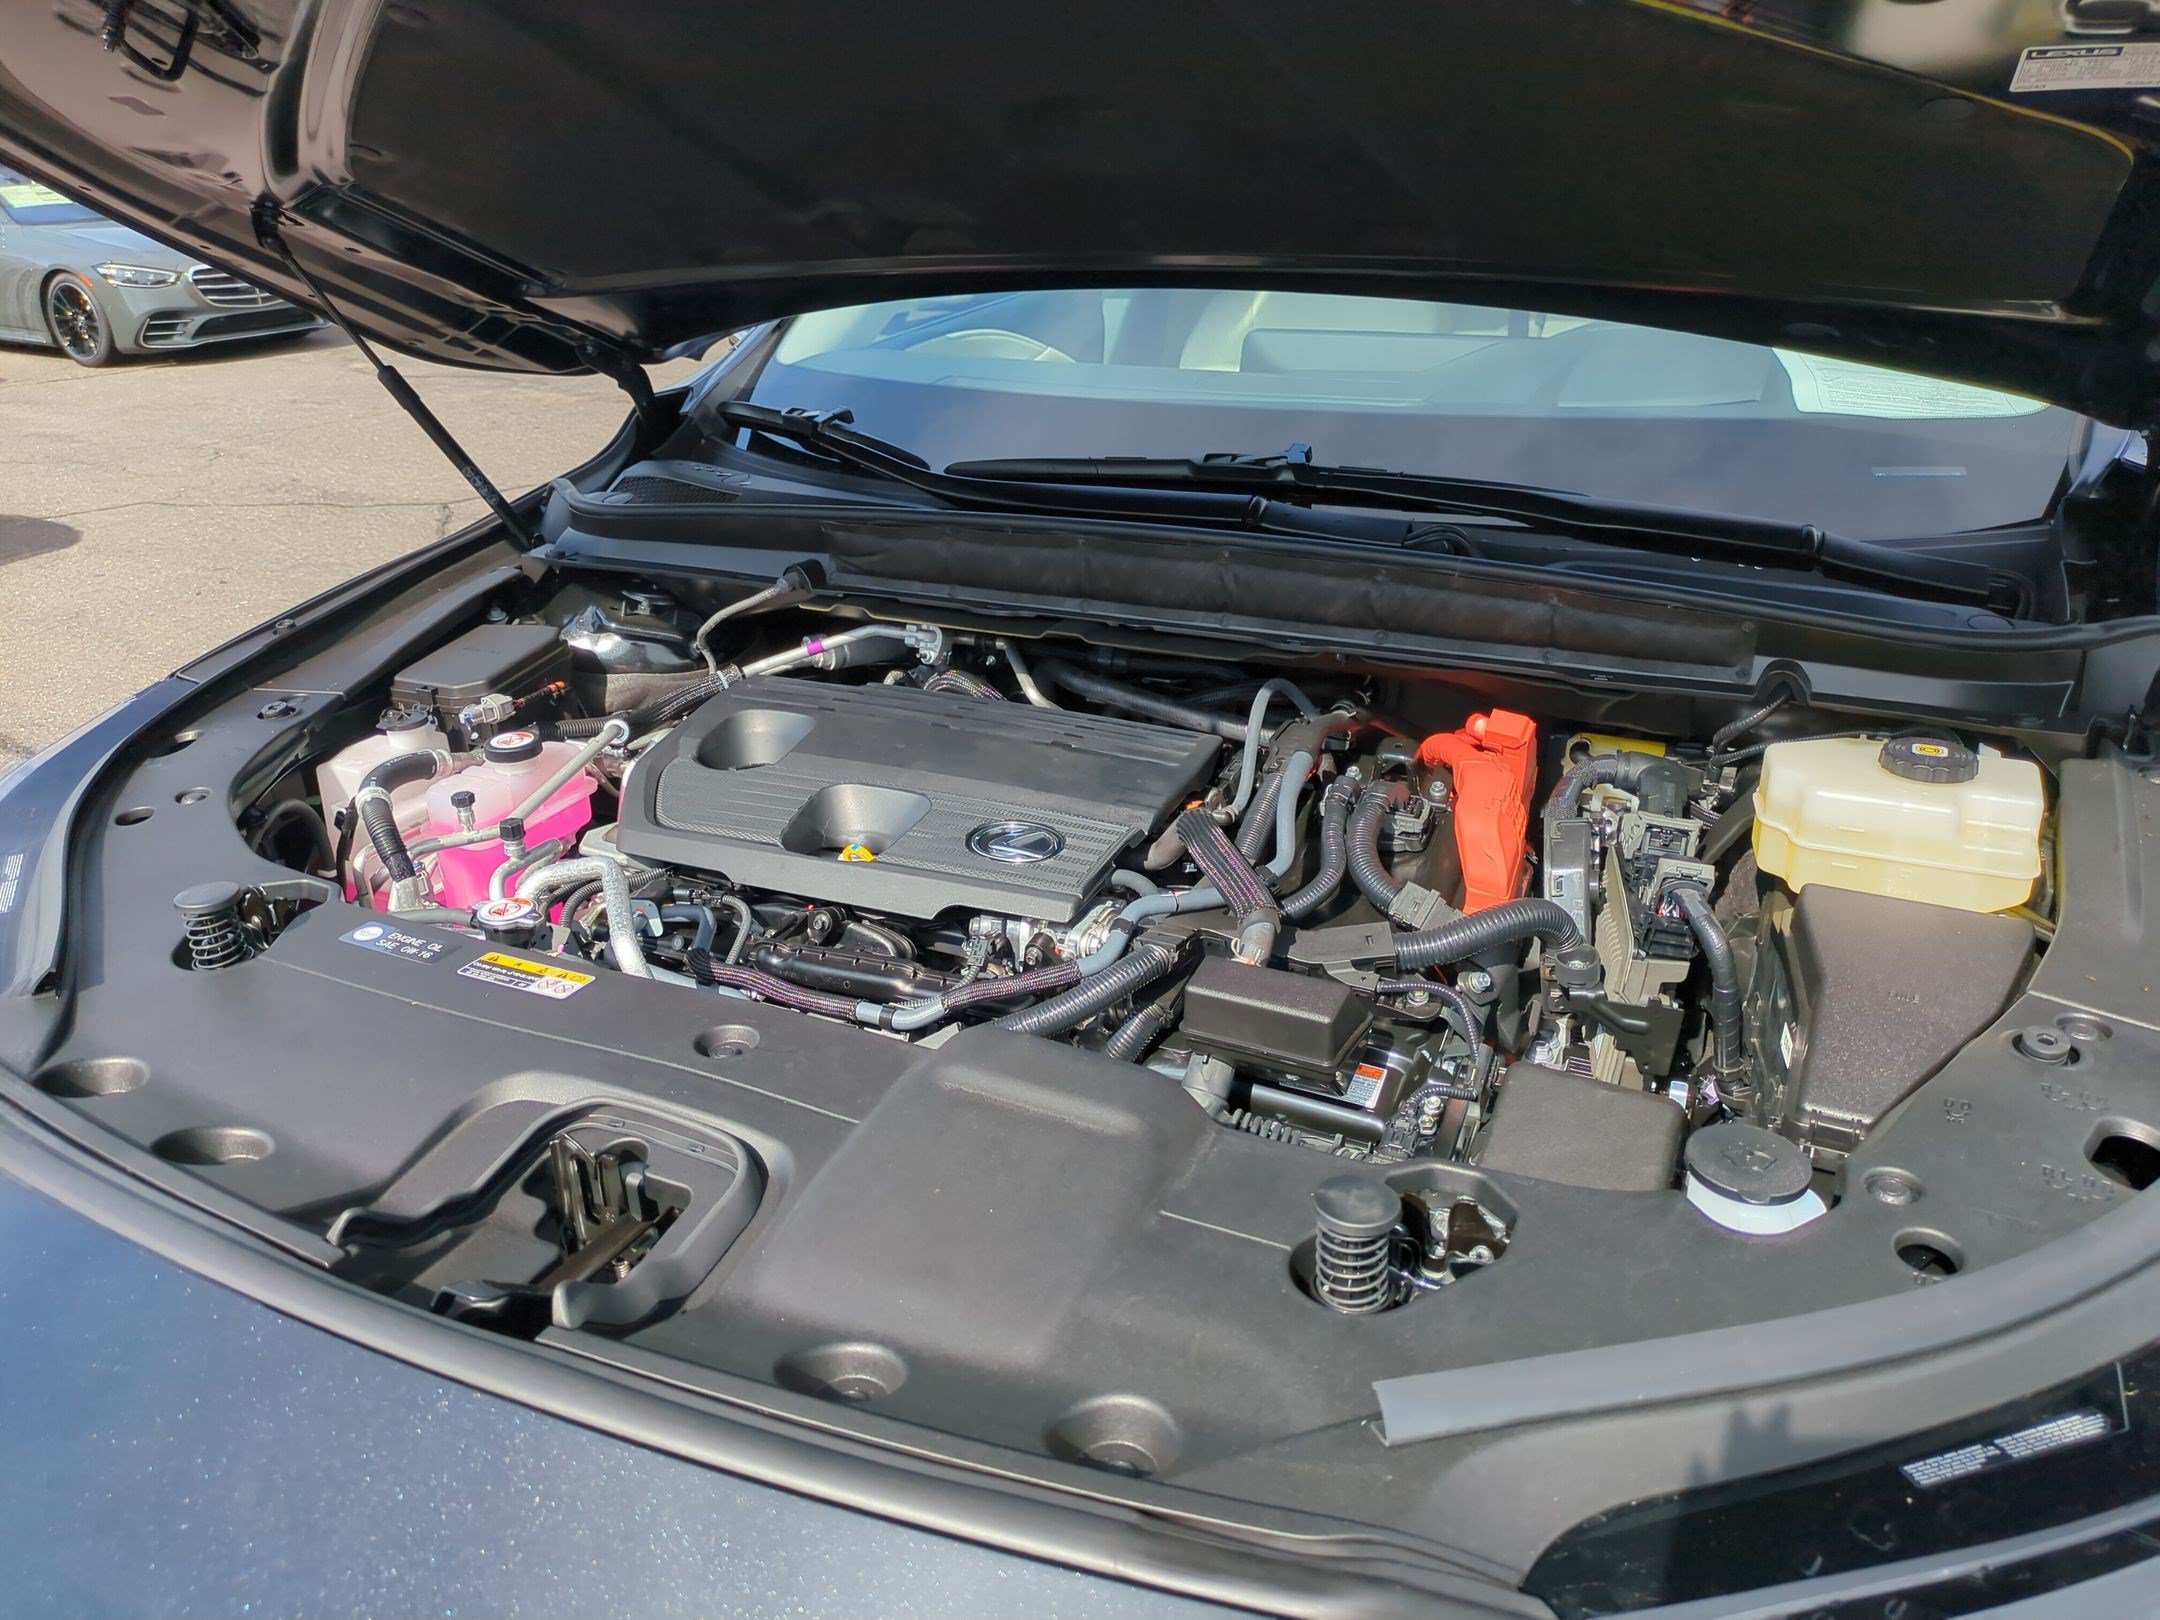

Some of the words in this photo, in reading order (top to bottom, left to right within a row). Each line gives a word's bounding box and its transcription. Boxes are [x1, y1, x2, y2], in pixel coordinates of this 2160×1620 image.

[2030, 48, 2119, 58] LEXUS
[375, 939, 400, 950] SAE
[400, 945, 434, 959] 0W-16
[387, 932, 427, 947] ENGINE
[427, 943, 443, 953] OIL
